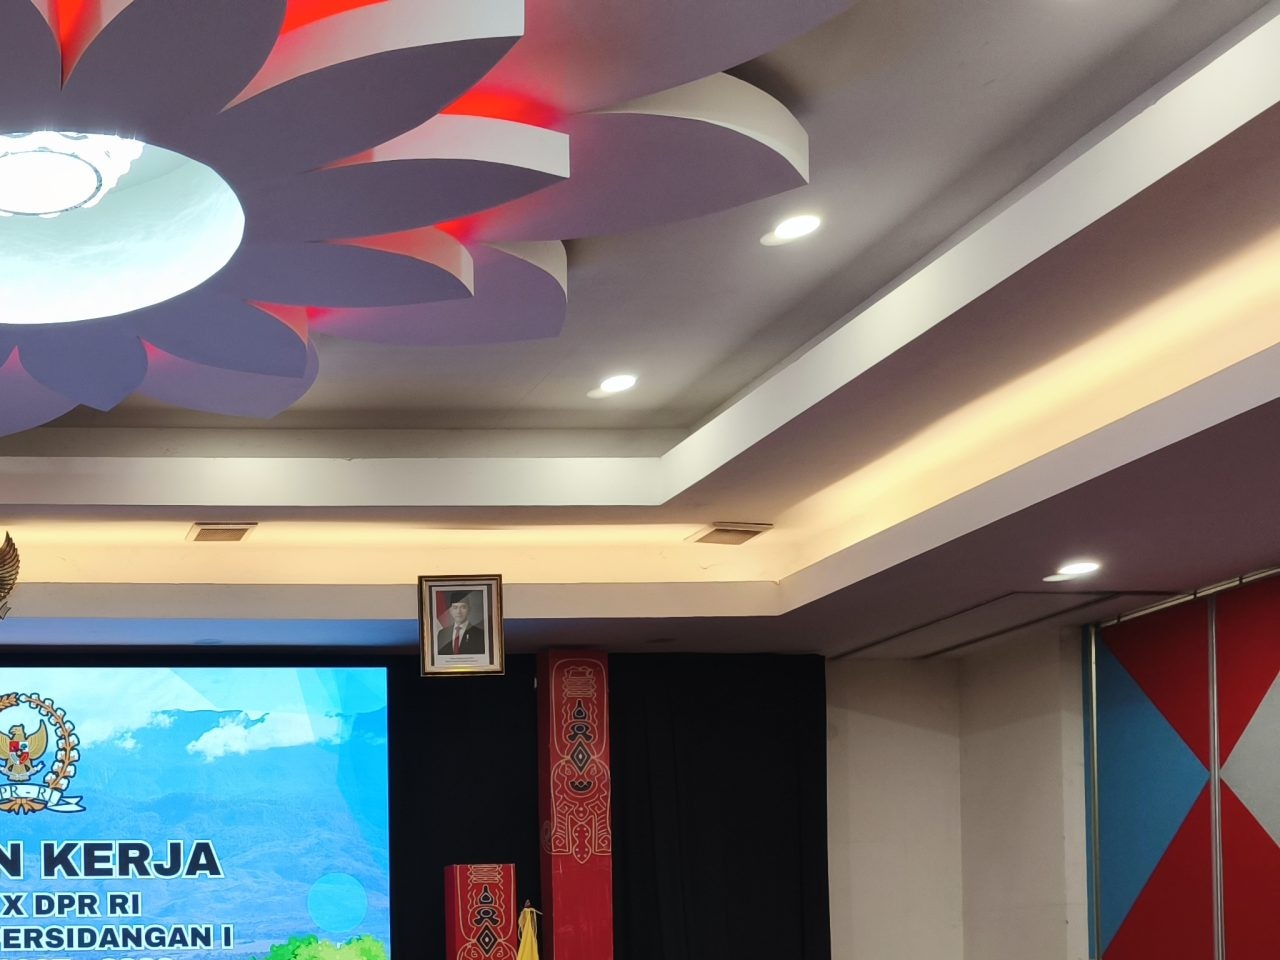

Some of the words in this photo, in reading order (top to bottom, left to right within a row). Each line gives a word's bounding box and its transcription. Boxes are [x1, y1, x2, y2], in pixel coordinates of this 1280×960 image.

[36, 786, 55, 803] RI
[42, 841, 223, 878] KERJA
[0, 893, 26, 916] X
[34, 893, 99, 916] DPR
[109, 893, 141, 915] RI
[223, 926, 232, 947] I
